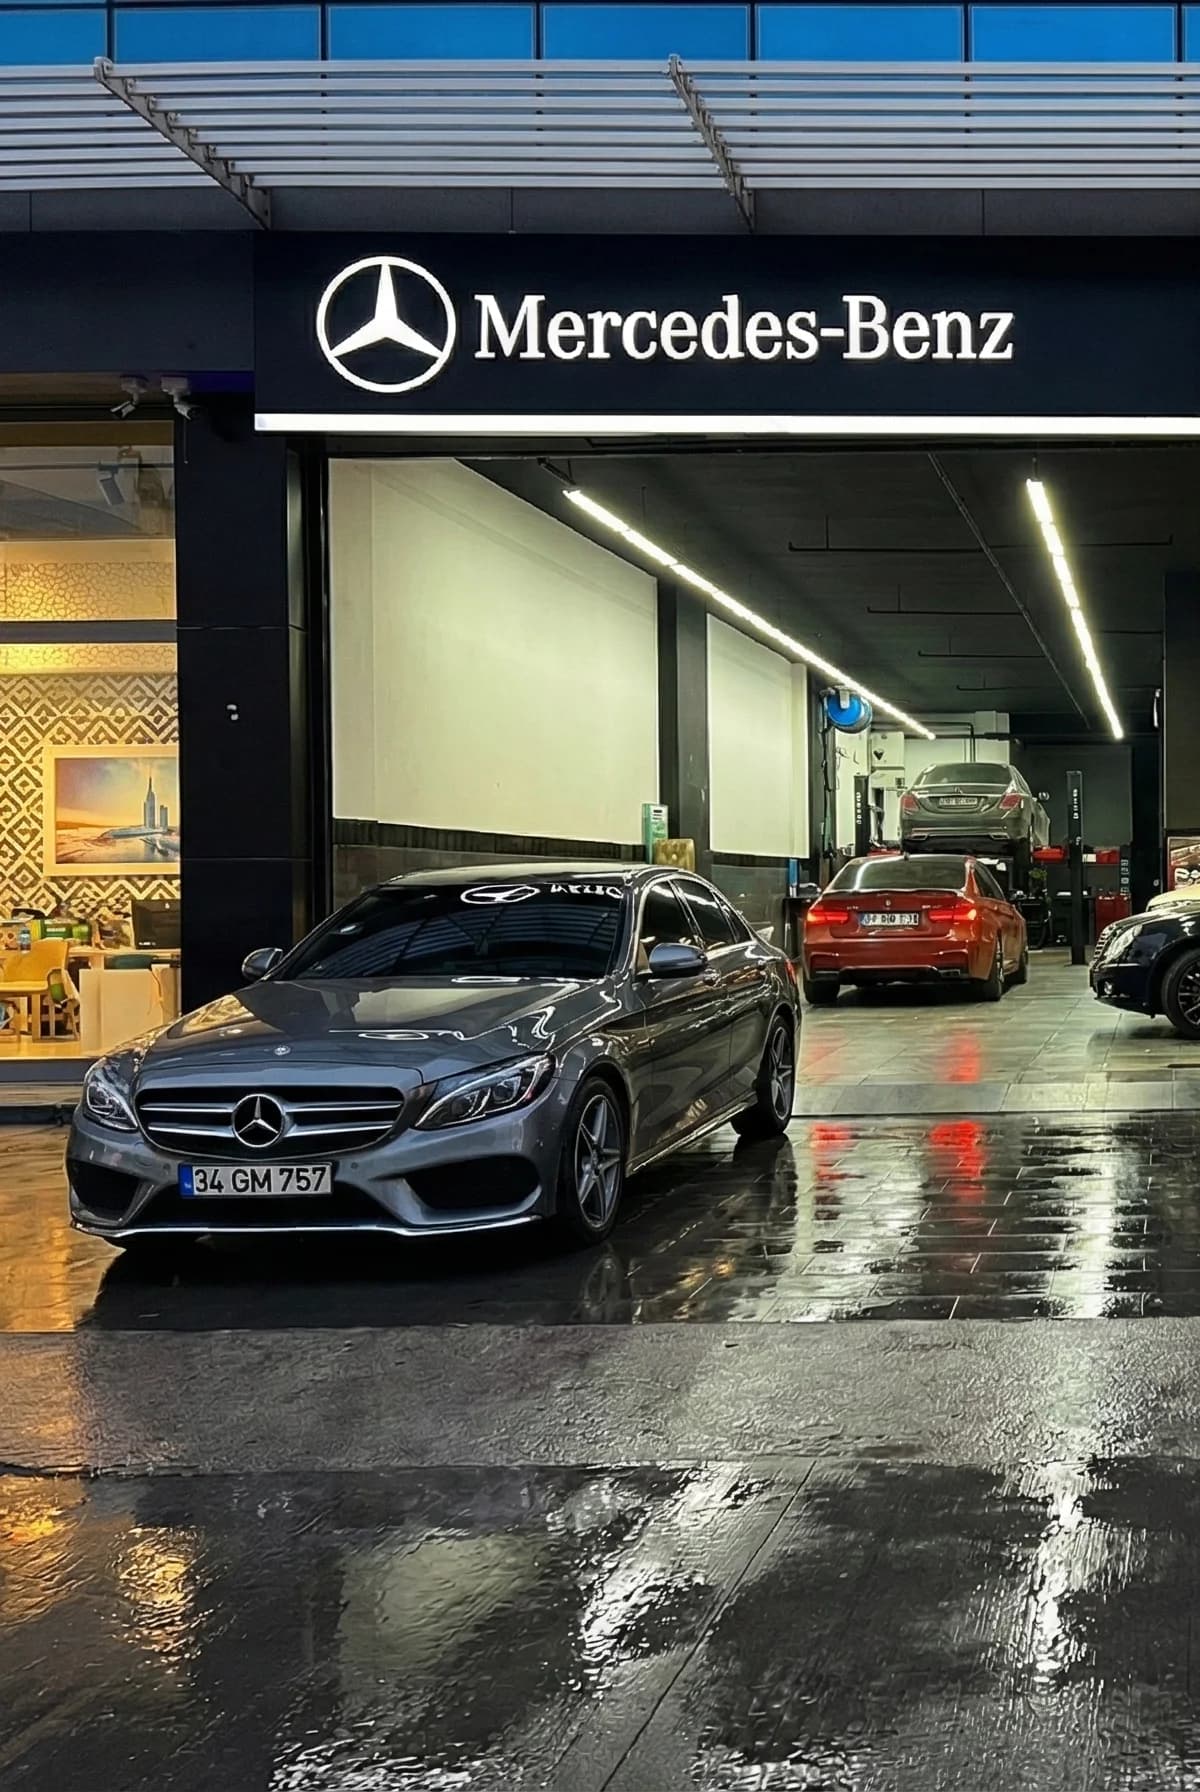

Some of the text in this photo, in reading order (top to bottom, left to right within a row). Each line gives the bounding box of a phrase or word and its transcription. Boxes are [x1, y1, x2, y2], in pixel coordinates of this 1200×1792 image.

[474, 294, 1014, 360] Mercedes-Benz
[194, 1166, 327, 1192] 34 GM 757
